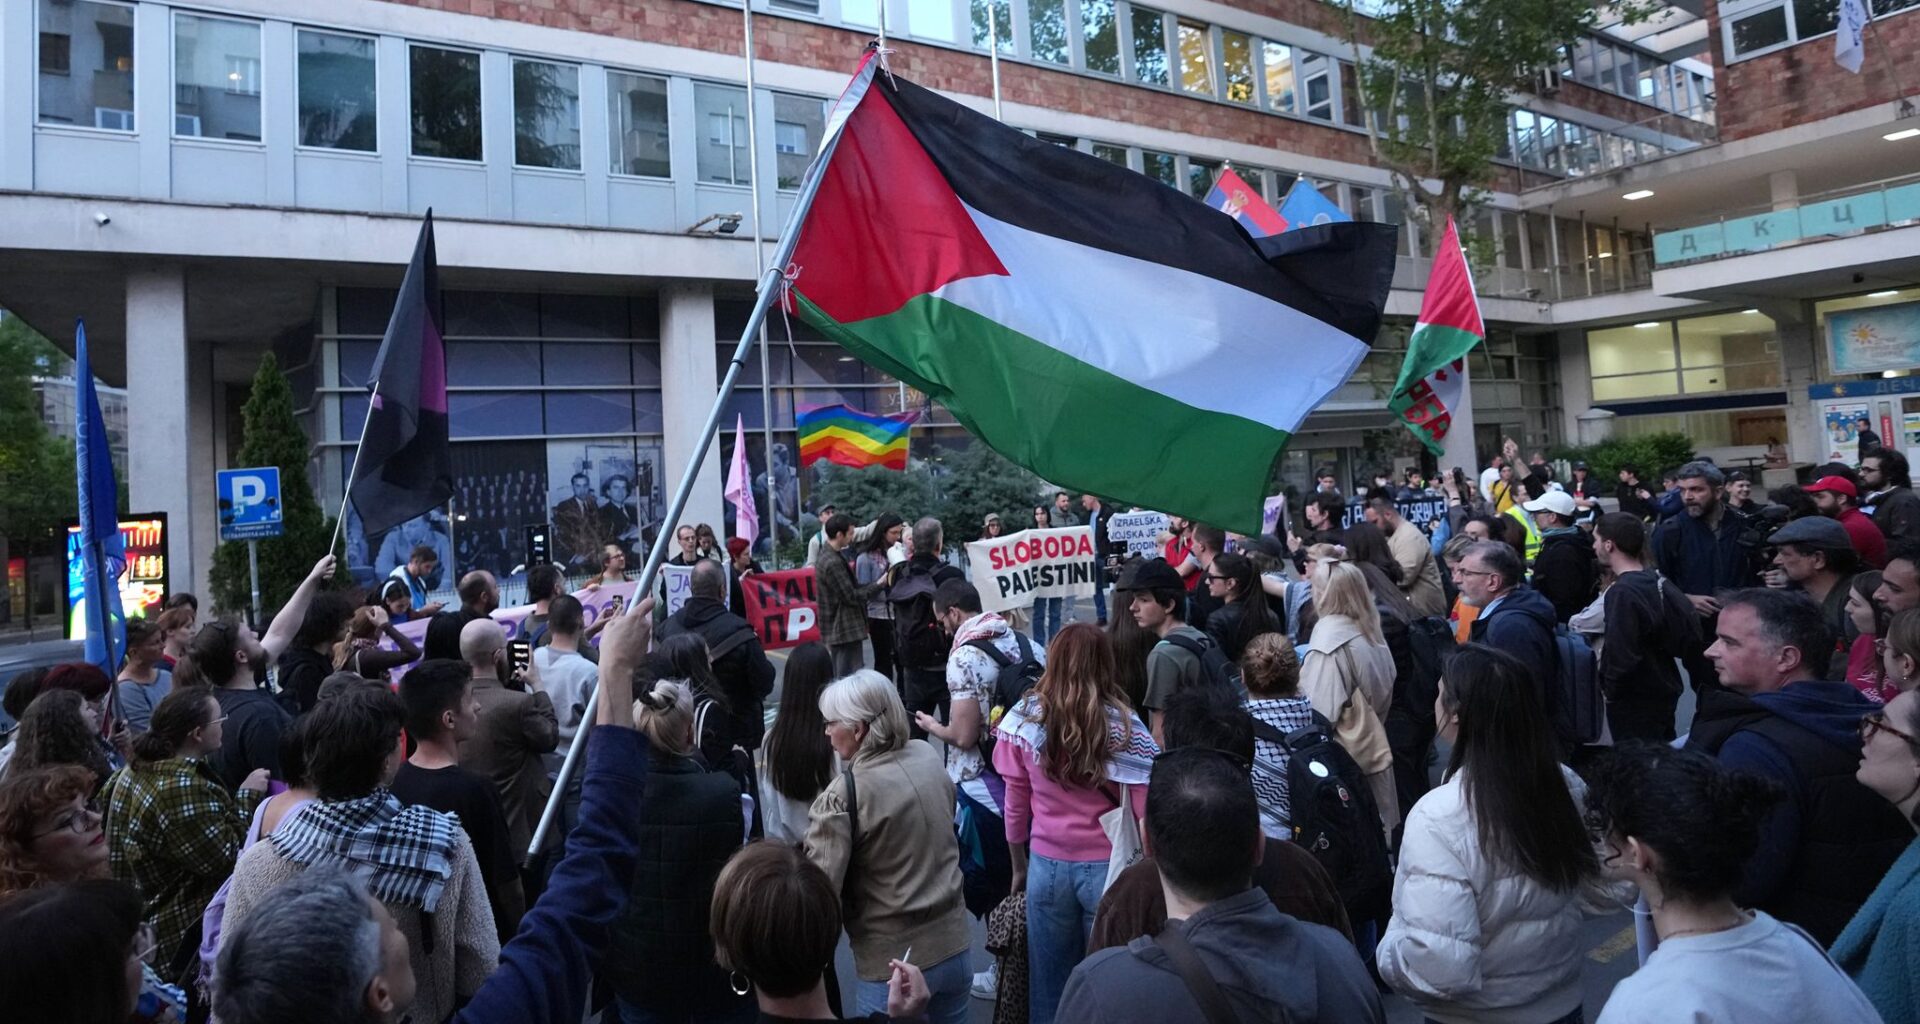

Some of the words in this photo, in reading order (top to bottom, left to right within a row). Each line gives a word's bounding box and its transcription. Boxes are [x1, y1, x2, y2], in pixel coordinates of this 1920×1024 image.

[1875, 378, 1920, 394] ДЕЧ
[231, 475, 266, 513] P
[1115, 516, 1162, 528] IZRAELSKA
[1146, 527, 1156, 538] JE
[989, 534, 1093, 571] SLOBODA
[996, 561, 1096, 599] PALESTINI
